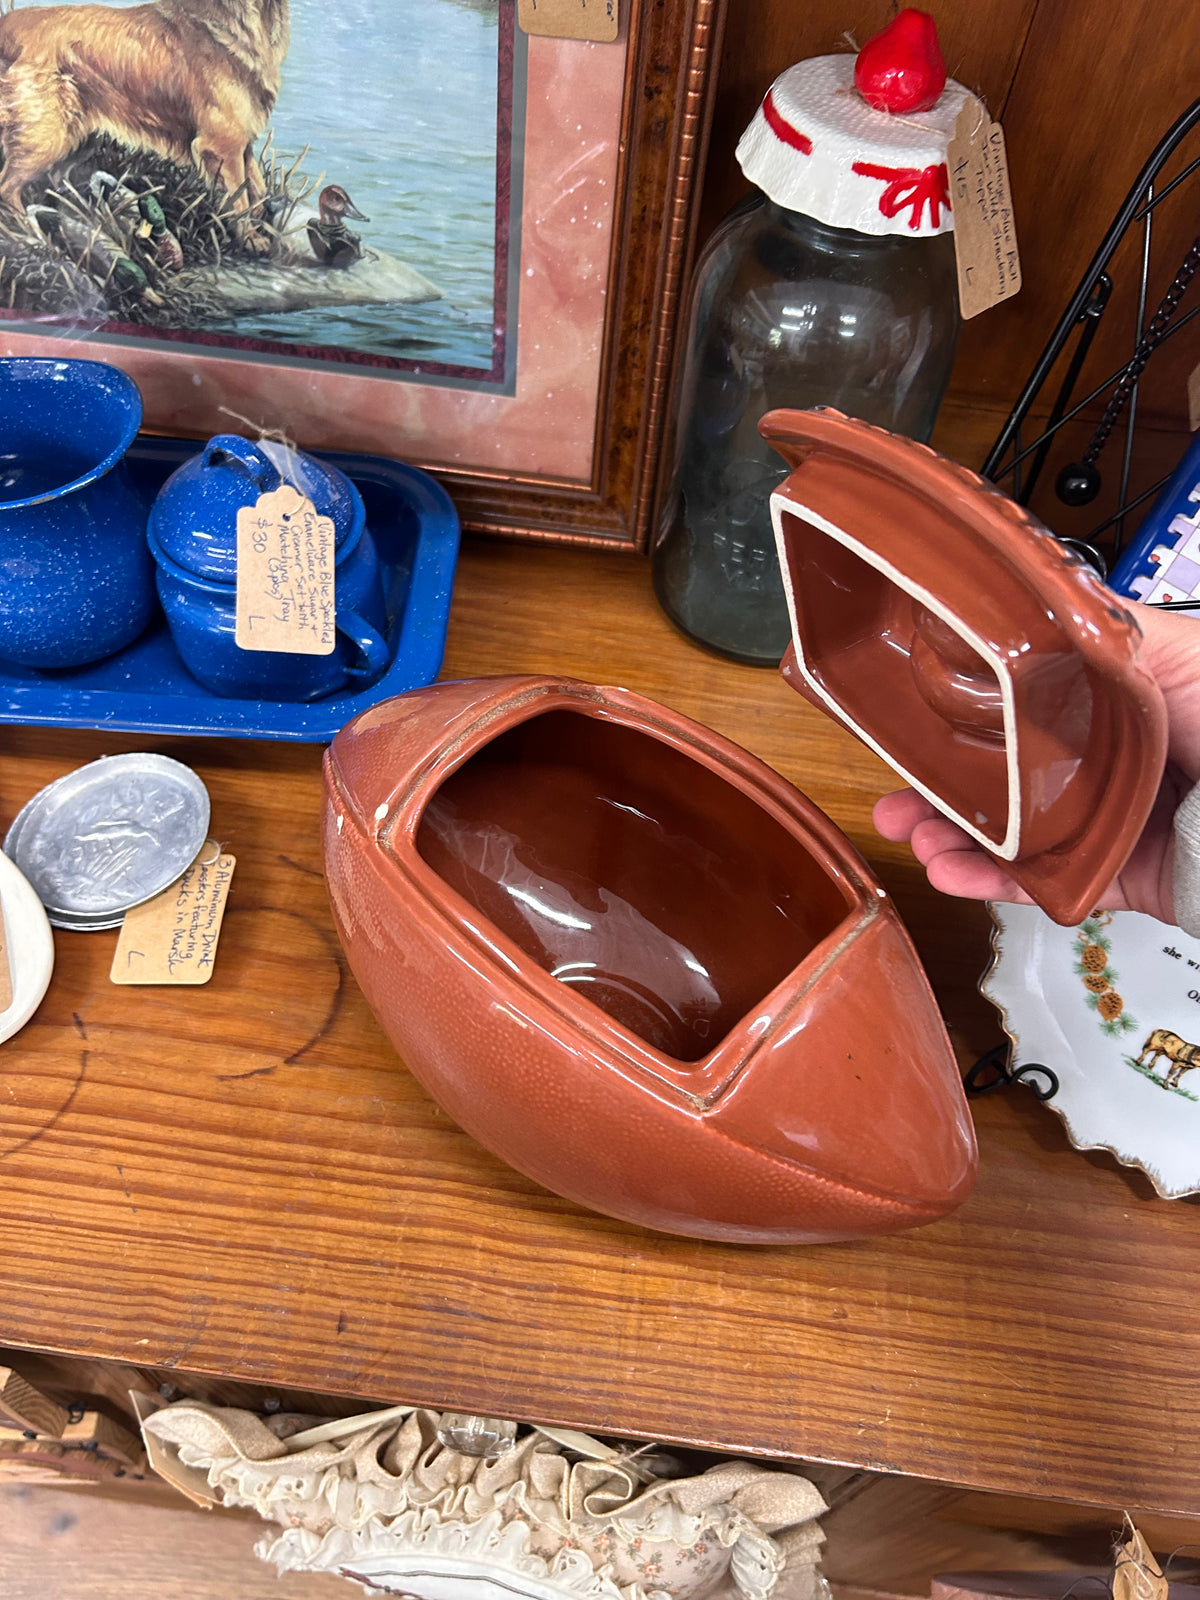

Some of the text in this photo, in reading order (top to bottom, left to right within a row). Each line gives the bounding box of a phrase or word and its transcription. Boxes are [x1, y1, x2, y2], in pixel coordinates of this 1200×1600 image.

[248, 517, 273, 554] $30
[304, 512, 320, 582] Enamelware
[273, 523, 297, 622] Matching Tray
[290, 525, 309, 631] Creamer Set with
[314, 522, 333, 644] Vintage Blue Speckled
[307, 586, 319, 621] Sugar
[248, 615, 266, 631] L
[218, 859, 232, 870] 3
[176, 911, 188, 924] in
[127, 950, 145, 969] L
[168, 928, 187, 975] Marsh
[197, 929, 218, 969] Drink
[1162, 946, 1182, 960] she
